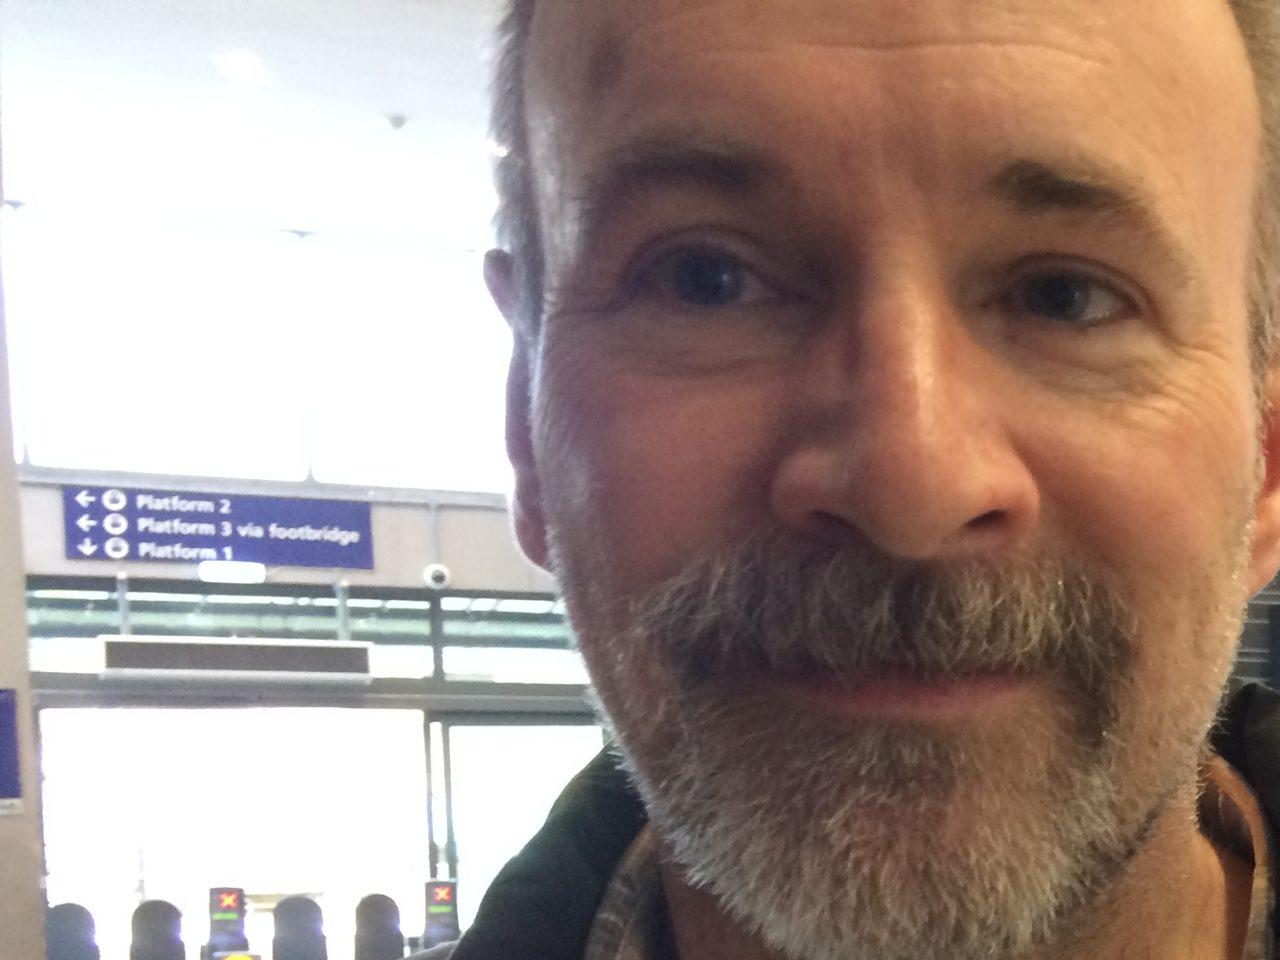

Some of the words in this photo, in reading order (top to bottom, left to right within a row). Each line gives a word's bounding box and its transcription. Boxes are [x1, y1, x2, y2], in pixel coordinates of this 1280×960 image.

[136, 494, 215, 514] Platform
[219, 499, 232, 514] 2
[137, 517, 216, 536] Platform
[220, 521, 232, 537] 3
[236, 523, 264, 539] via
[268, 523, 360, 546] footbridge
[138, 542, 217, 560] Platform
[222, 545, 233, 560] 1
